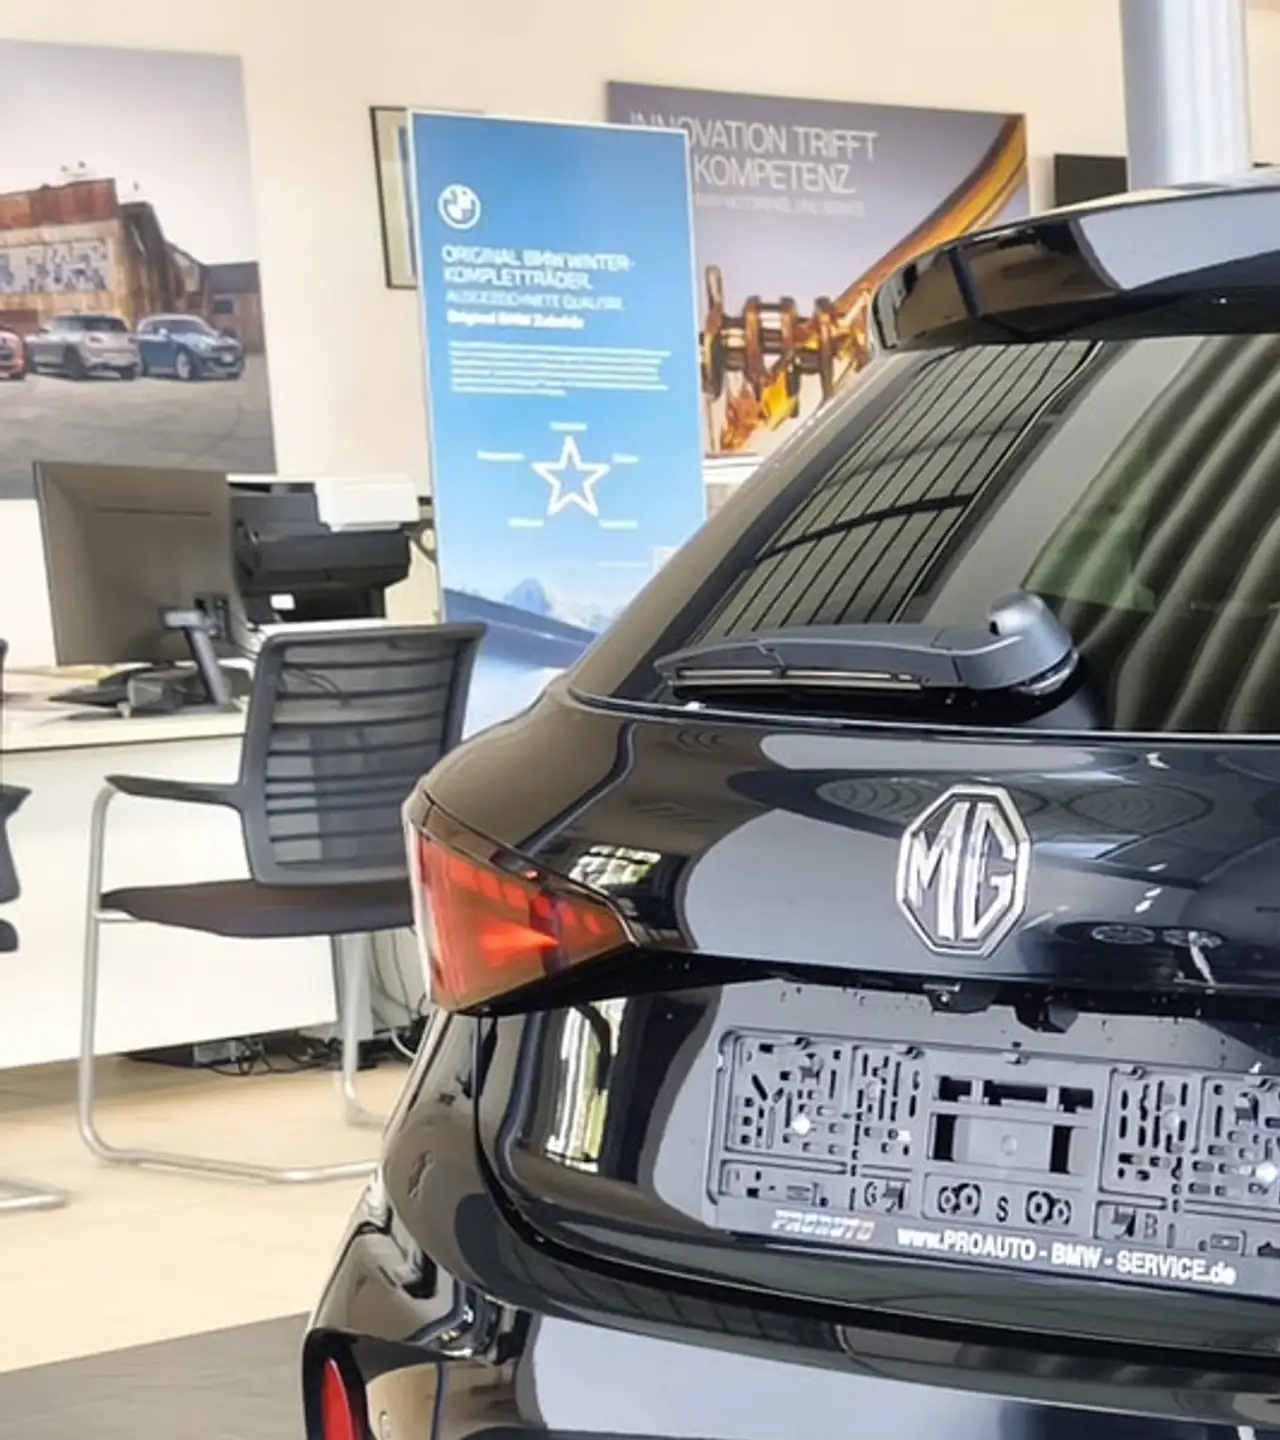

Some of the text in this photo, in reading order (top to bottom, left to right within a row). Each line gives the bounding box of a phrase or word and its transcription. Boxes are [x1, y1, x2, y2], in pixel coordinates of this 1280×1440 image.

[793, 125, 878, 162] TRIFFT
[693, 155, 857, 194] KOMPETENZ
[907, 801, 1017, 941] MG
[896, 1227, 1037, 1262] www.PROAUTO
[1051, 1242, 1103, 1270] BMW
[1116, 1250, 1237, 1286] SERVICE.de
